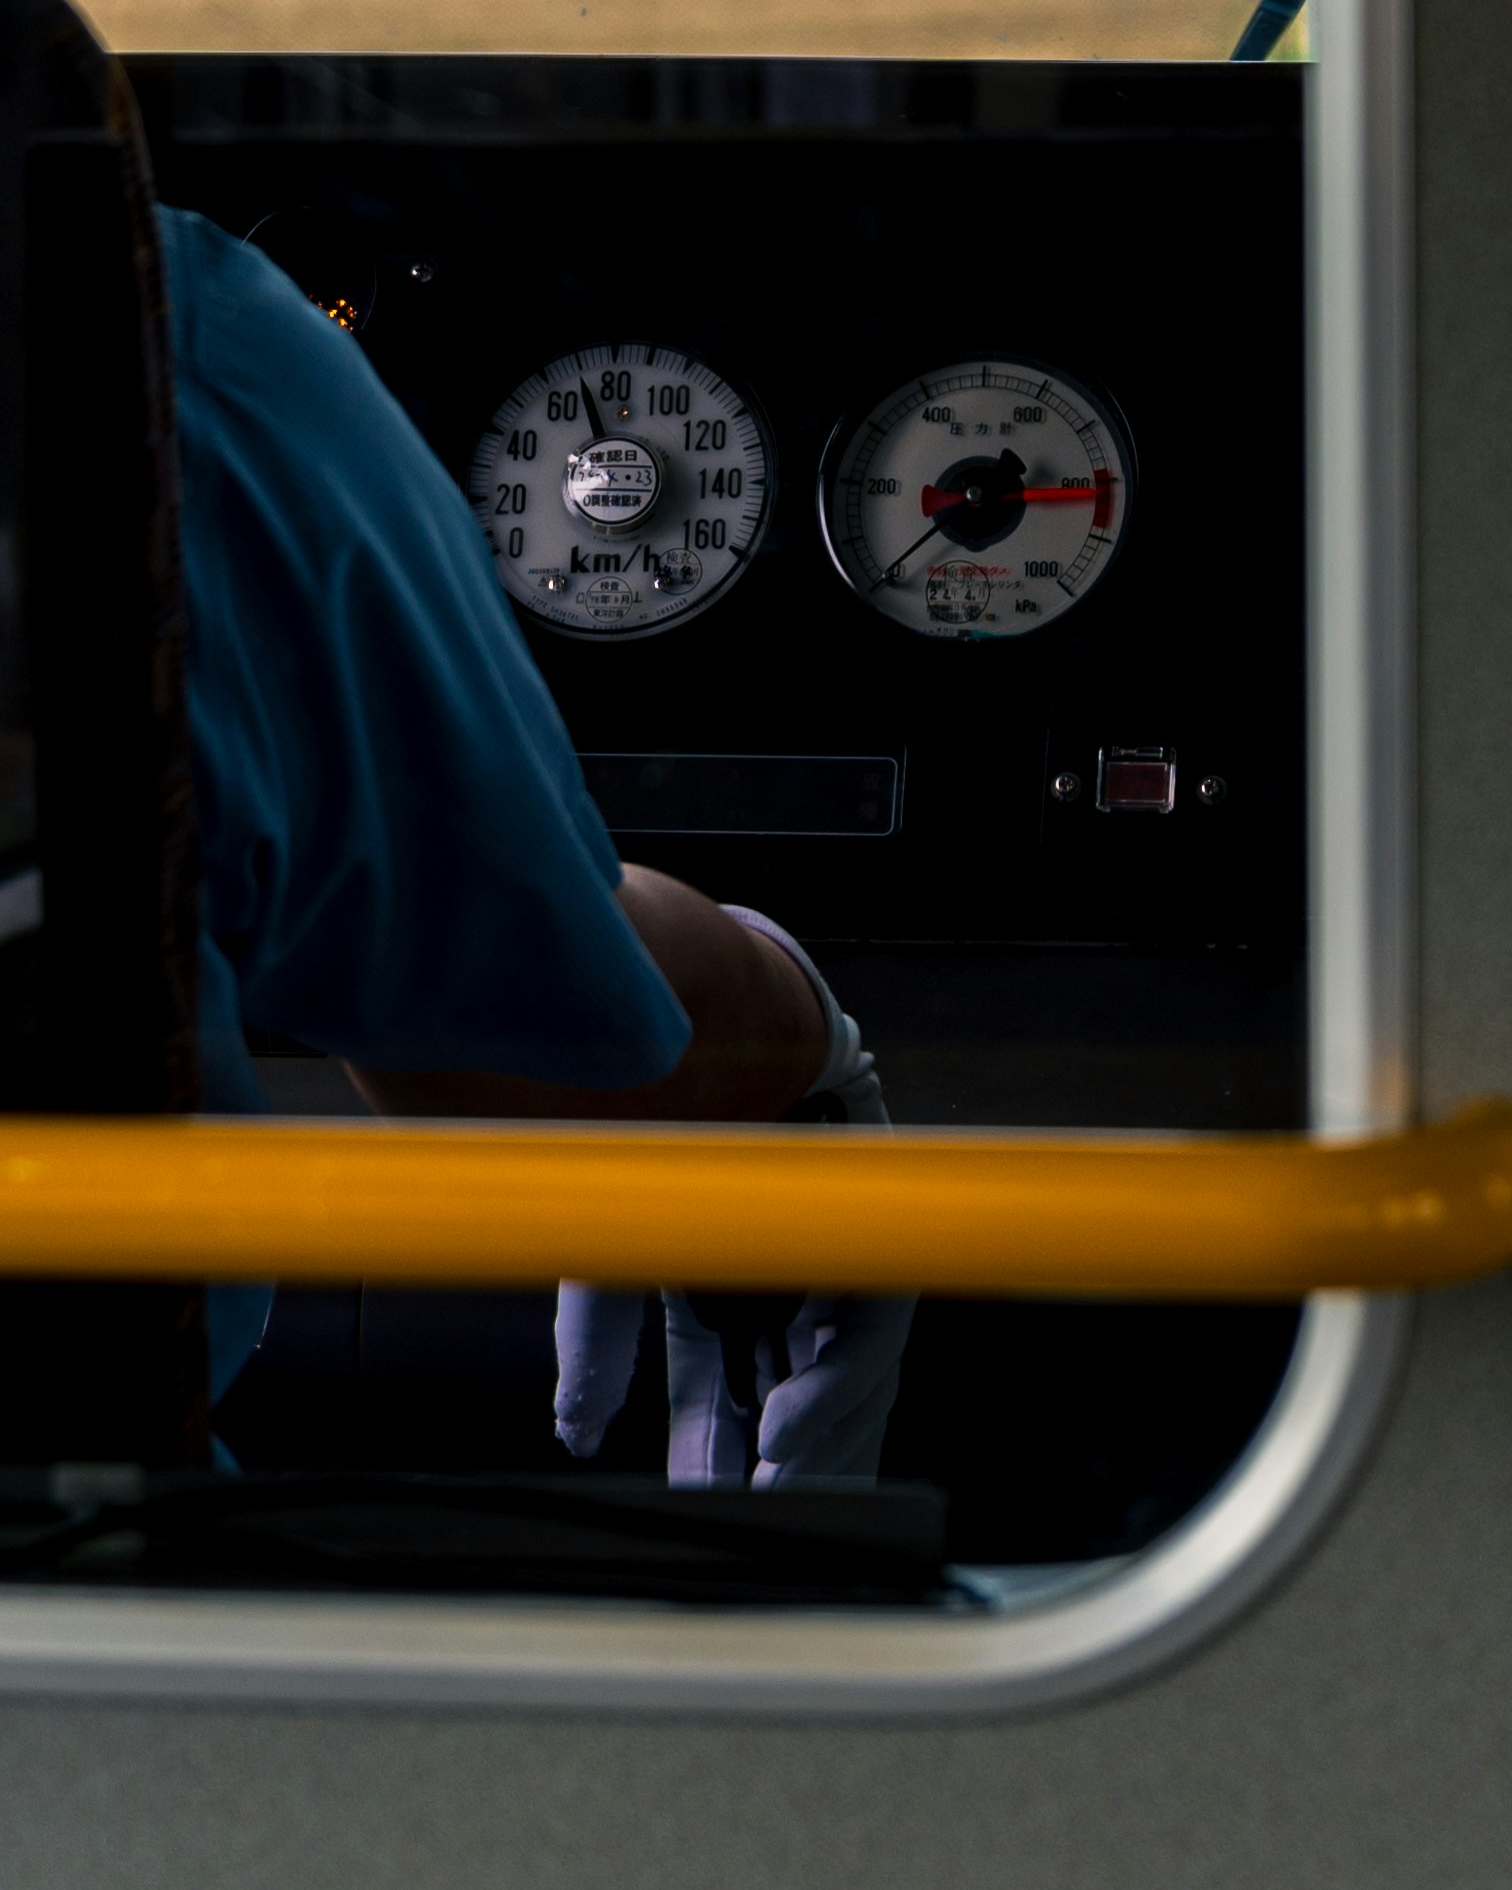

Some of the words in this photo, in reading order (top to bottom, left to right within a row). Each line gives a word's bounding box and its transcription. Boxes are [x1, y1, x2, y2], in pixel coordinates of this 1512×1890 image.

[600, 371, 631, 402] 80
[647, 384, 690, 416] 100
[547, 391, 578, 422] 60
[921, 407, 952, 423] 400
[1013, 406, 1043, 423] 600
[506, 429, 537, 461] 40
[683, 420, 726, 451] 120
[589, 448, 638, 463] 確認日
[495, 483, 527, 515] 20
[698, 468, 743, 499] 140
[867, 478, 897, 495] 200
[508, 527, 524, 558] 0
[682, 518, 726, 550] 160
[570, 543, 661, 574] km/h
[1024, 561, 1059, 578] 1000
[1014, 598, 1037, 614] kPa
